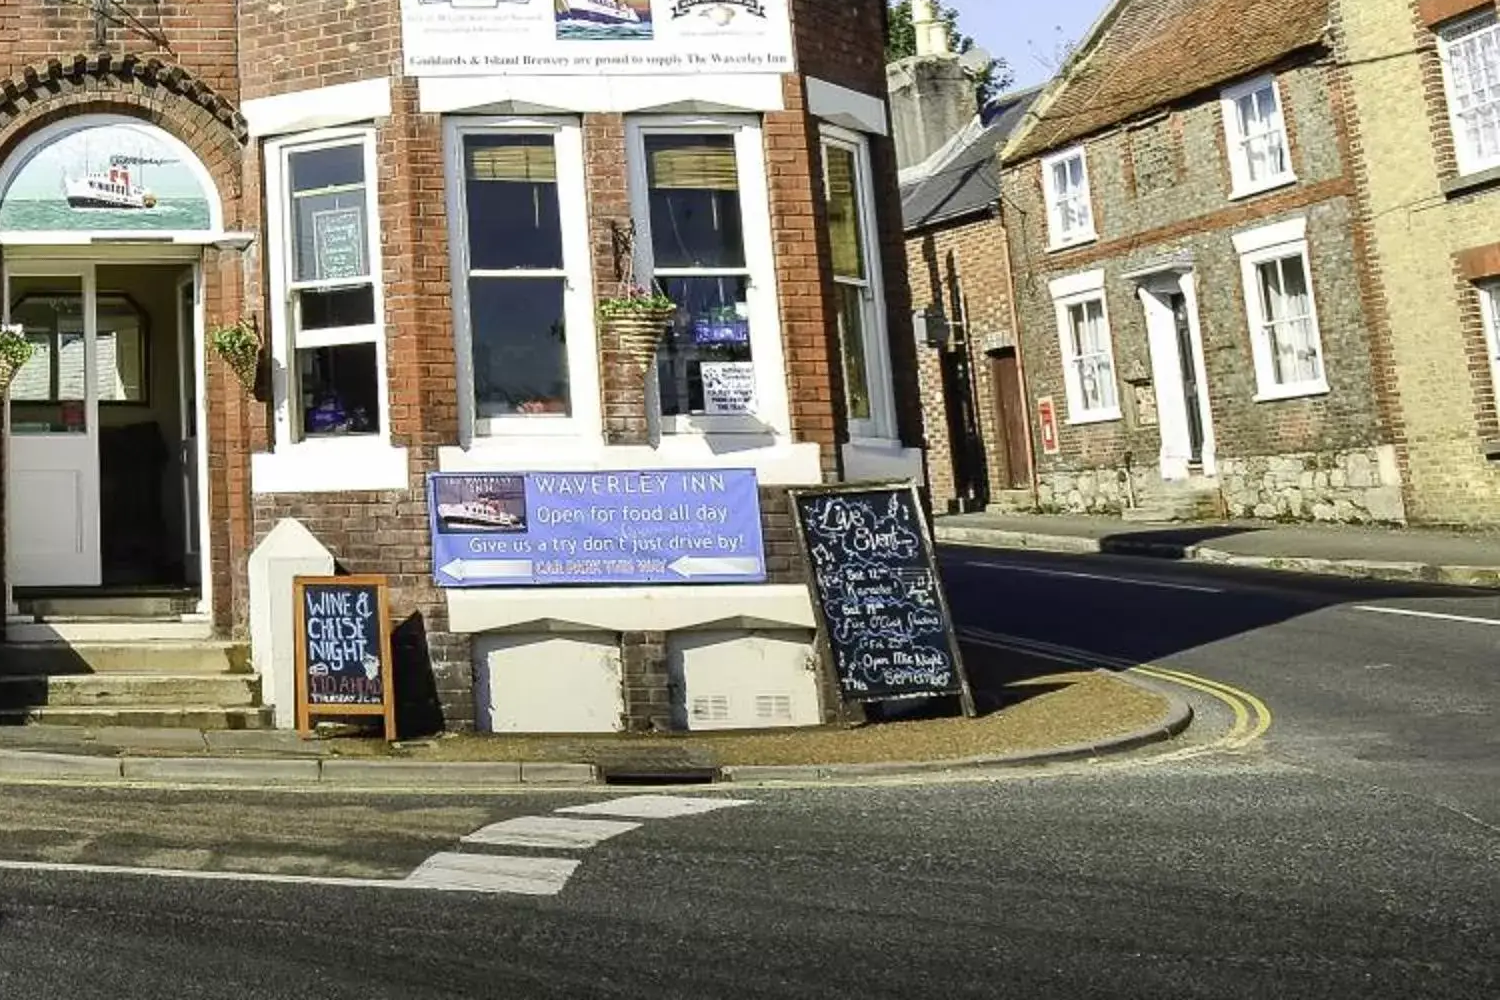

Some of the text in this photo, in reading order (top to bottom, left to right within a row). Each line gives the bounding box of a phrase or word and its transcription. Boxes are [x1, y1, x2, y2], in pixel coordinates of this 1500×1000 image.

[469, 56, 481, 66] &
[485, 55, 519, 65] Island
[523, 55, 569, 68] Brewery
[595, 54, 629, 67] proud
[631, 55, 643, 64] to
[646, 54, 682, 67] supply
[686, 53, 707, 64] The
[710, 53, 763, 65] Waverley
[767, 53, 787, 63] Inn
[536, 473, 725, 494] WAVERLEY INN
[536, 503, 728, 527] Open for food all day
[469, 537, 507, 553] Give
[513, 540, 532, 553] us
[537, 540, 547, 552] a
[552, 539, 577, 555] try
[631, 534, 665, 553] just
[669, 534, 713, 550] drive
[717, 533, 744, 553] by!
[306, 591, 373, 619] WINE &
[307, 617, 365, 639] CHEESE
[863, 653, 890, 671] Open
